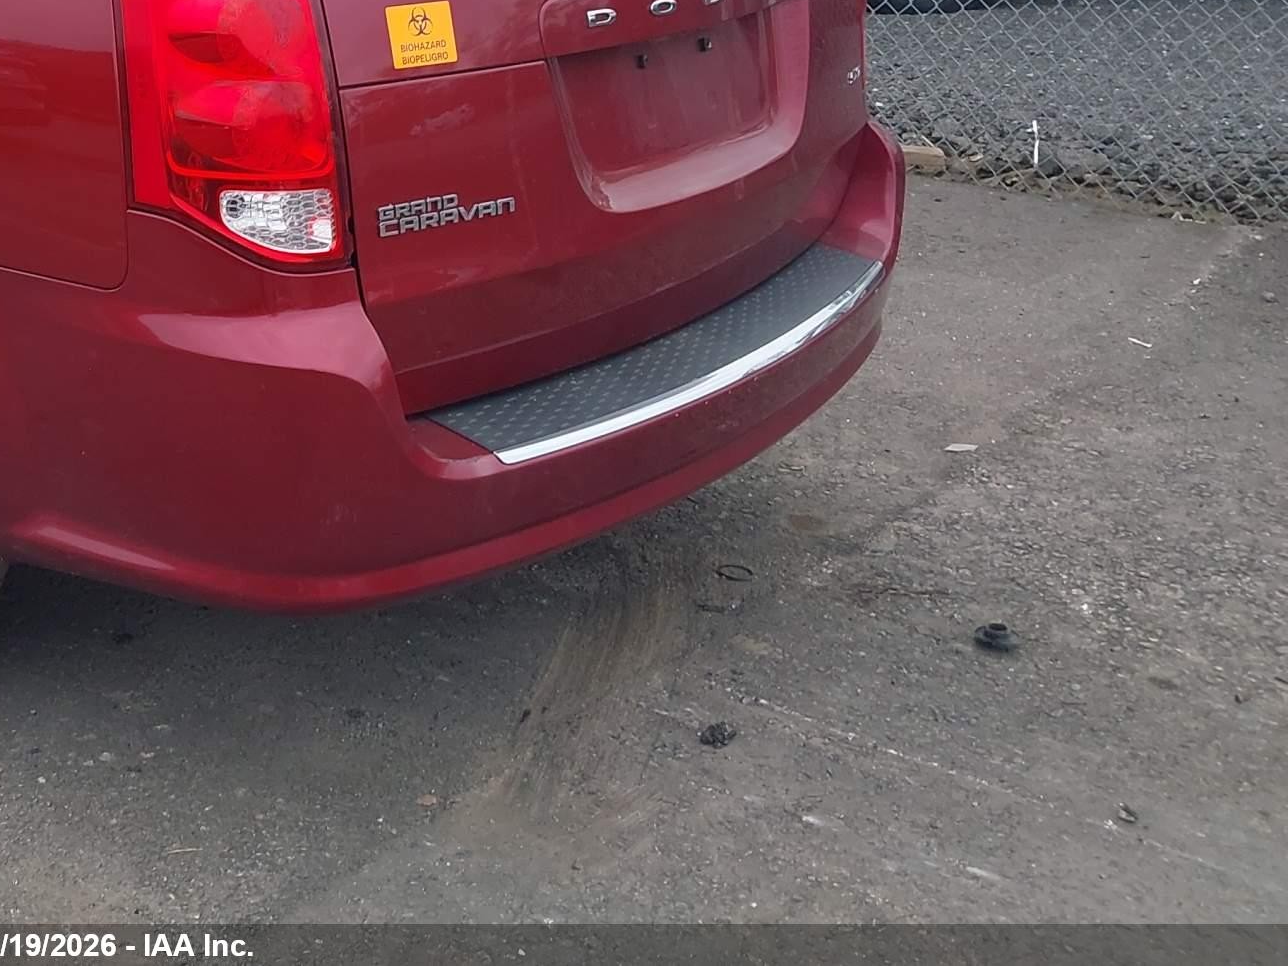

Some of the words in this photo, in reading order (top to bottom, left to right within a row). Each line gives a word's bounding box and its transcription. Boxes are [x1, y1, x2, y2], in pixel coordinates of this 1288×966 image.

[400, 39, 447, 53] BIOHAZARD
[402, 51, 449, 65] BIOPELIGRO
[378, 193, 459, 221] GRAND
[379, 196, 516, 238] CARAVAN
